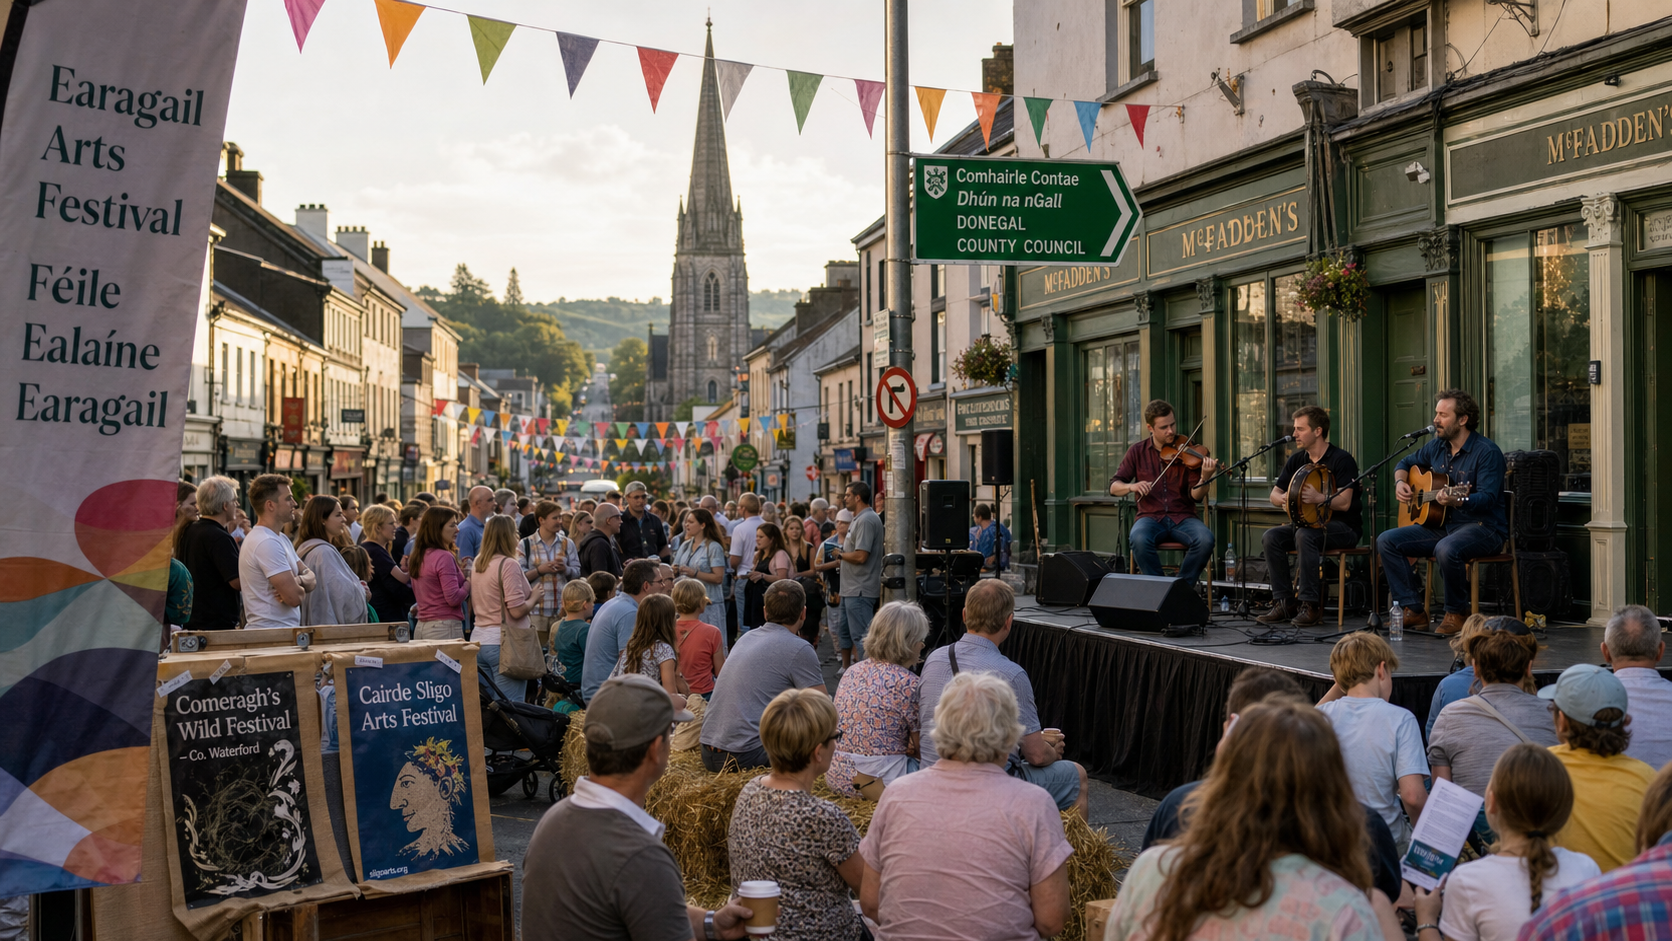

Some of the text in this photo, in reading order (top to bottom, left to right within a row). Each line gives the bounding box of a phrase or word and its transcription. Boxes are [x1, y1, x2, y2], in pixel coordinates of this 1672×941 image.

[49, 64, 205, 130] Earagail
[40, 124, 126, 172] Arts
[956, 168, 1079, 186] Comhairle Contae
[35, 181, 184, 237] Festival
[957, 190, 1062, 209] Dhún na nGall
[957, 215, 1027, 231] DONEGAL
[957, 238, 1086, 255] COUNTY COUNCIL
[27, 263, 121, 309] Féile
[21, 322, 160, 371] Ealaíne
[16, 382, 168, 436] Earagail
[175, 687, 281, 715] Comeragh's
[359, 681, 452, 705] Cairde Sligo
[177, 709, 292, 741] Wild Festival
[361, 703, 457, 731] Arts Festival
[189, 750, 207, 761] Co.
[208, 741, 261, 759] Waterford
